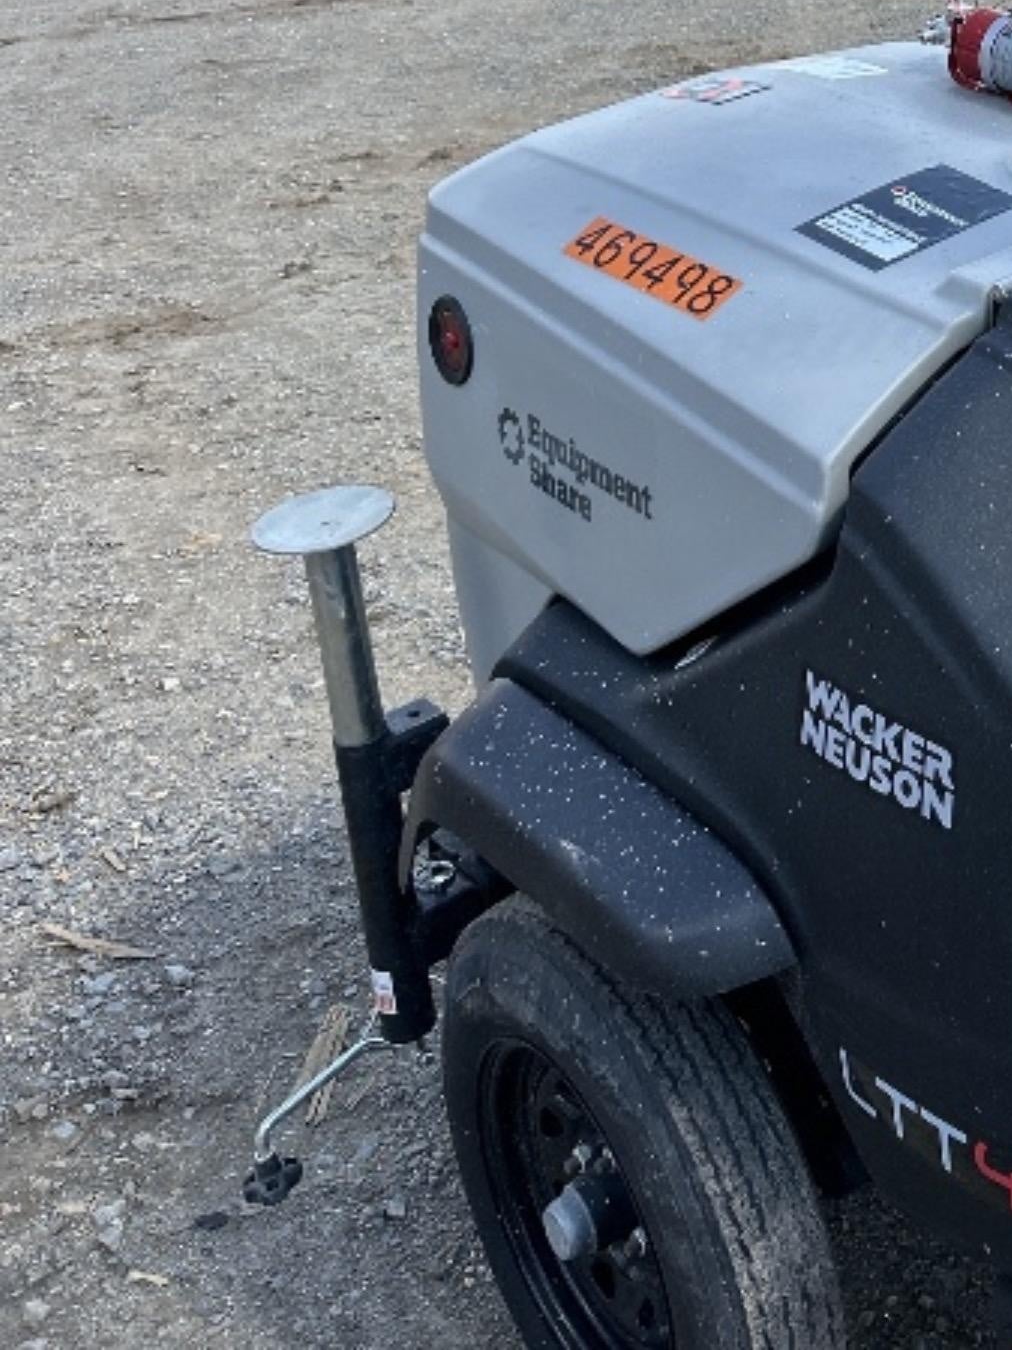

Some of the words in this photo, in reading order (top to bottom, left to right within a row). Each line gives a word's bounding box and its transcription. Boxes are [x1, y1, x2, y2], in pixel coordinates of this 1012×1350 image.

[573, 223, 735, 314] 469498
[527, 413, 653, 520] Equipment
[528, 452, 592, 523] Share
[800, 709, 955, 830] NEUSON
[806, 668, 955, 791] WACKER
